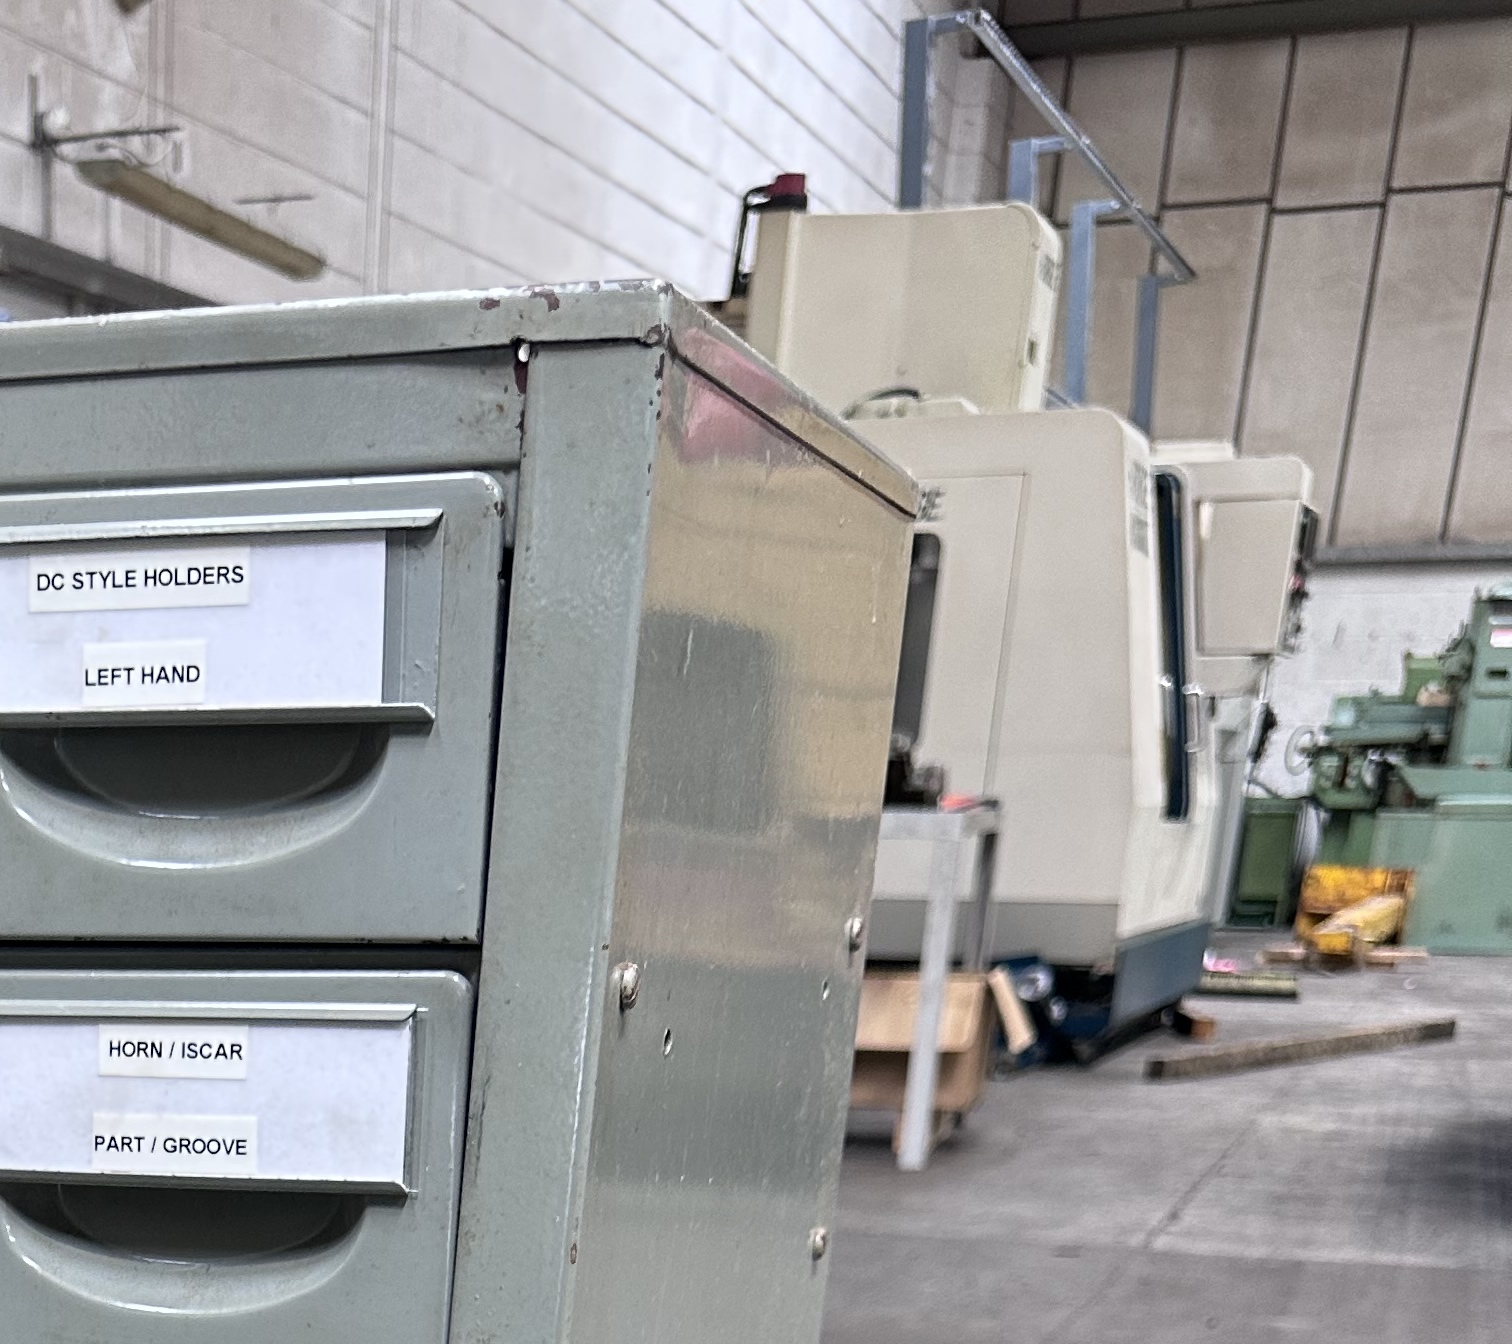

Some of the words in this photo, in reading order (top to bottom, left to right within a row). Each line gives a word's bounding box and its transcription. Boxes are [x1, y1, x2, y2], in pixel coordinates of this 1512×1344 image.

[36, 572, 65, 592] DC
[71, 569, 137, 590] STYLE
[144, 565, 244, 588] HOLDERS
[85, 667, 135, 687] LEFT
[141, 665, 201, 685] HAND
[109, 1040, 163, 1059] HORN
[181, 1042, 243, 1061] ISCAR
[94, 1135, 146, 1153] PART
[162, 1137, 248, 1156] GROOVE
